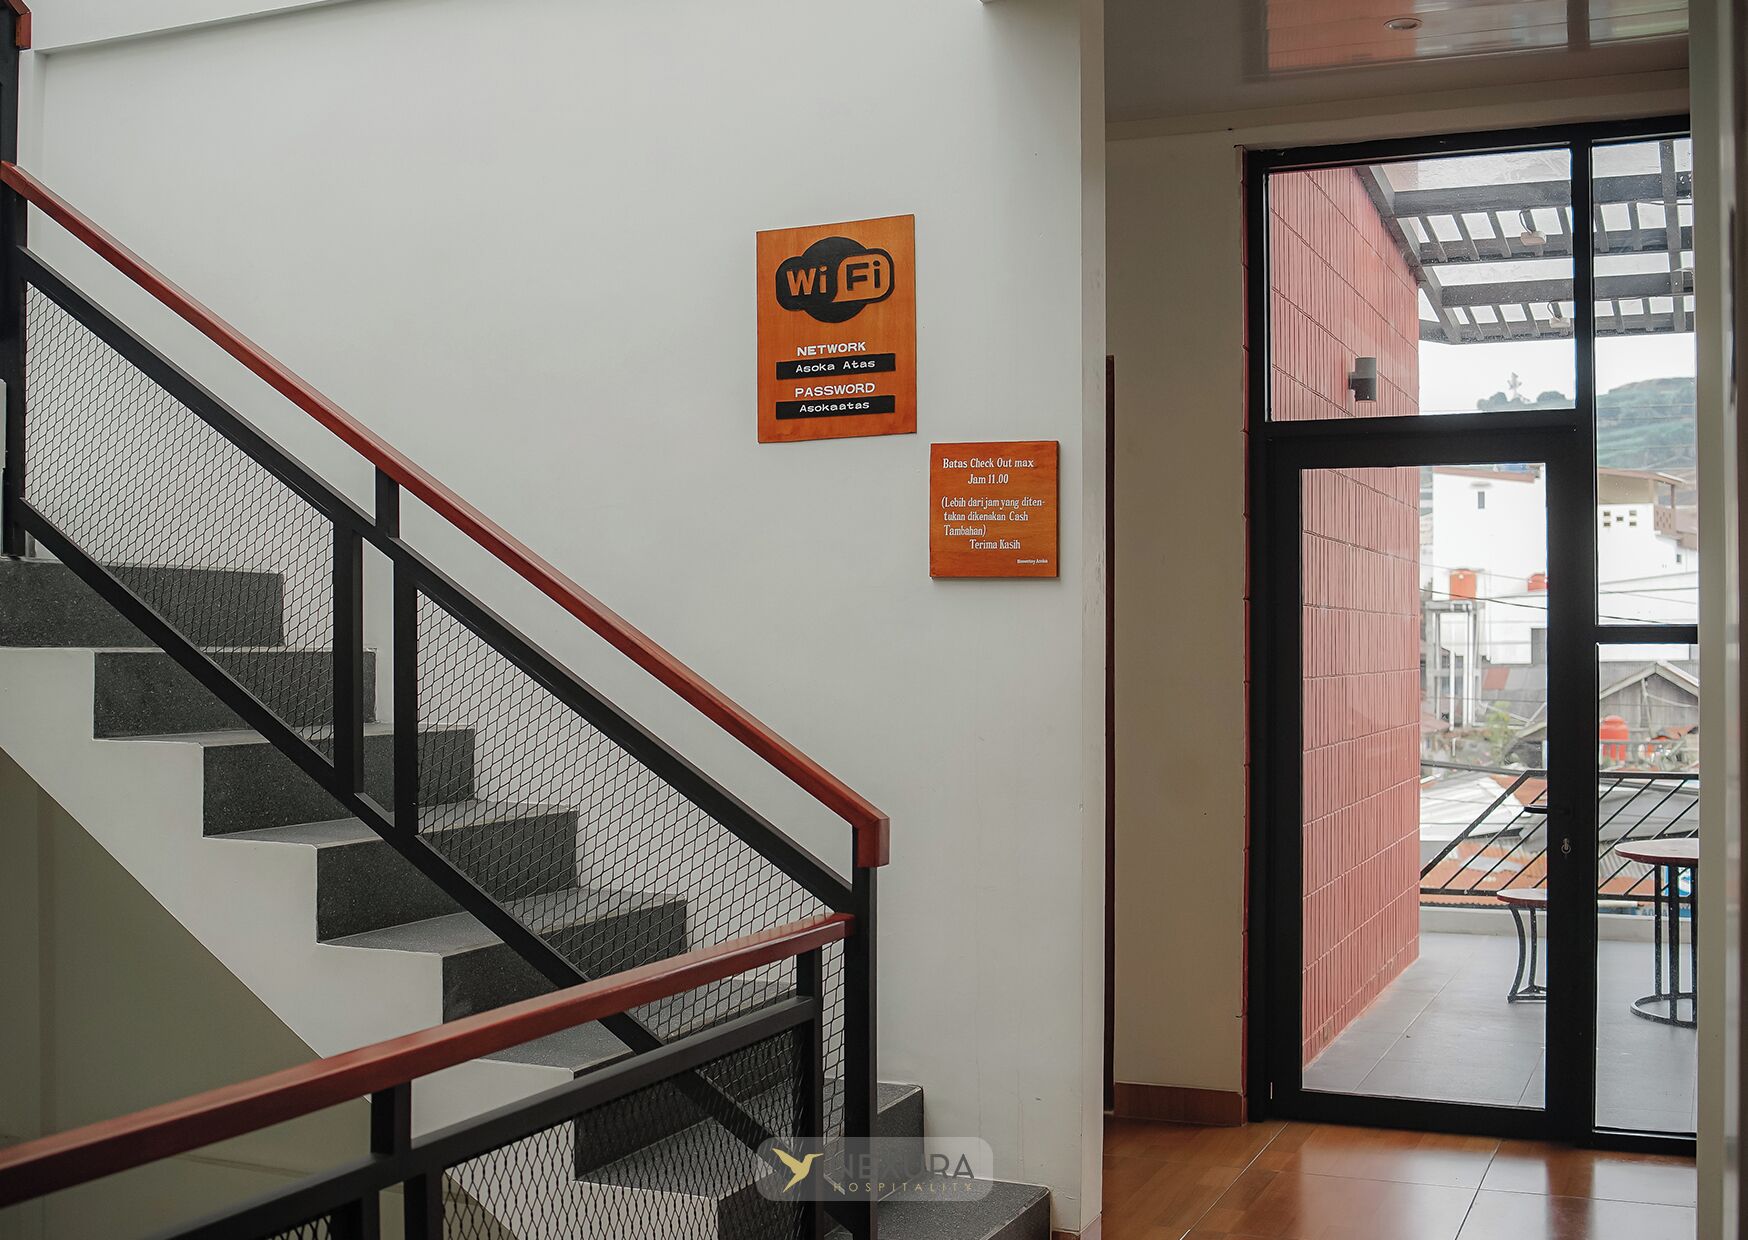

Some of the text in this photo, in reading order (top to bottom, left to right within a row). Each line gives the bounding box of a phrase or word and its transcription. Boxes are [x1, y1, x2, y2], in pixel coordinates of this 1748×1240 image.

[796, 341, 866, 357] NETWORK
[795, 359, 876, 374] Asoka Atas
[795, 382, 876, 398] PASSWORD
[799, 400, 870, 413] Asokaatas
[943, 456, 1034, 469] Batas Check Out max
[967, 473, 1009, 485] Jam 11.00
[941, 496, 1045, 510] (Lebih dari jam yang diten-
[943, 511, 1029, 521] tukan dikenakan Cash
[943, 524, 987, 537] Tambahan)
[969, 538, 1021, 550] Terima Kasih
